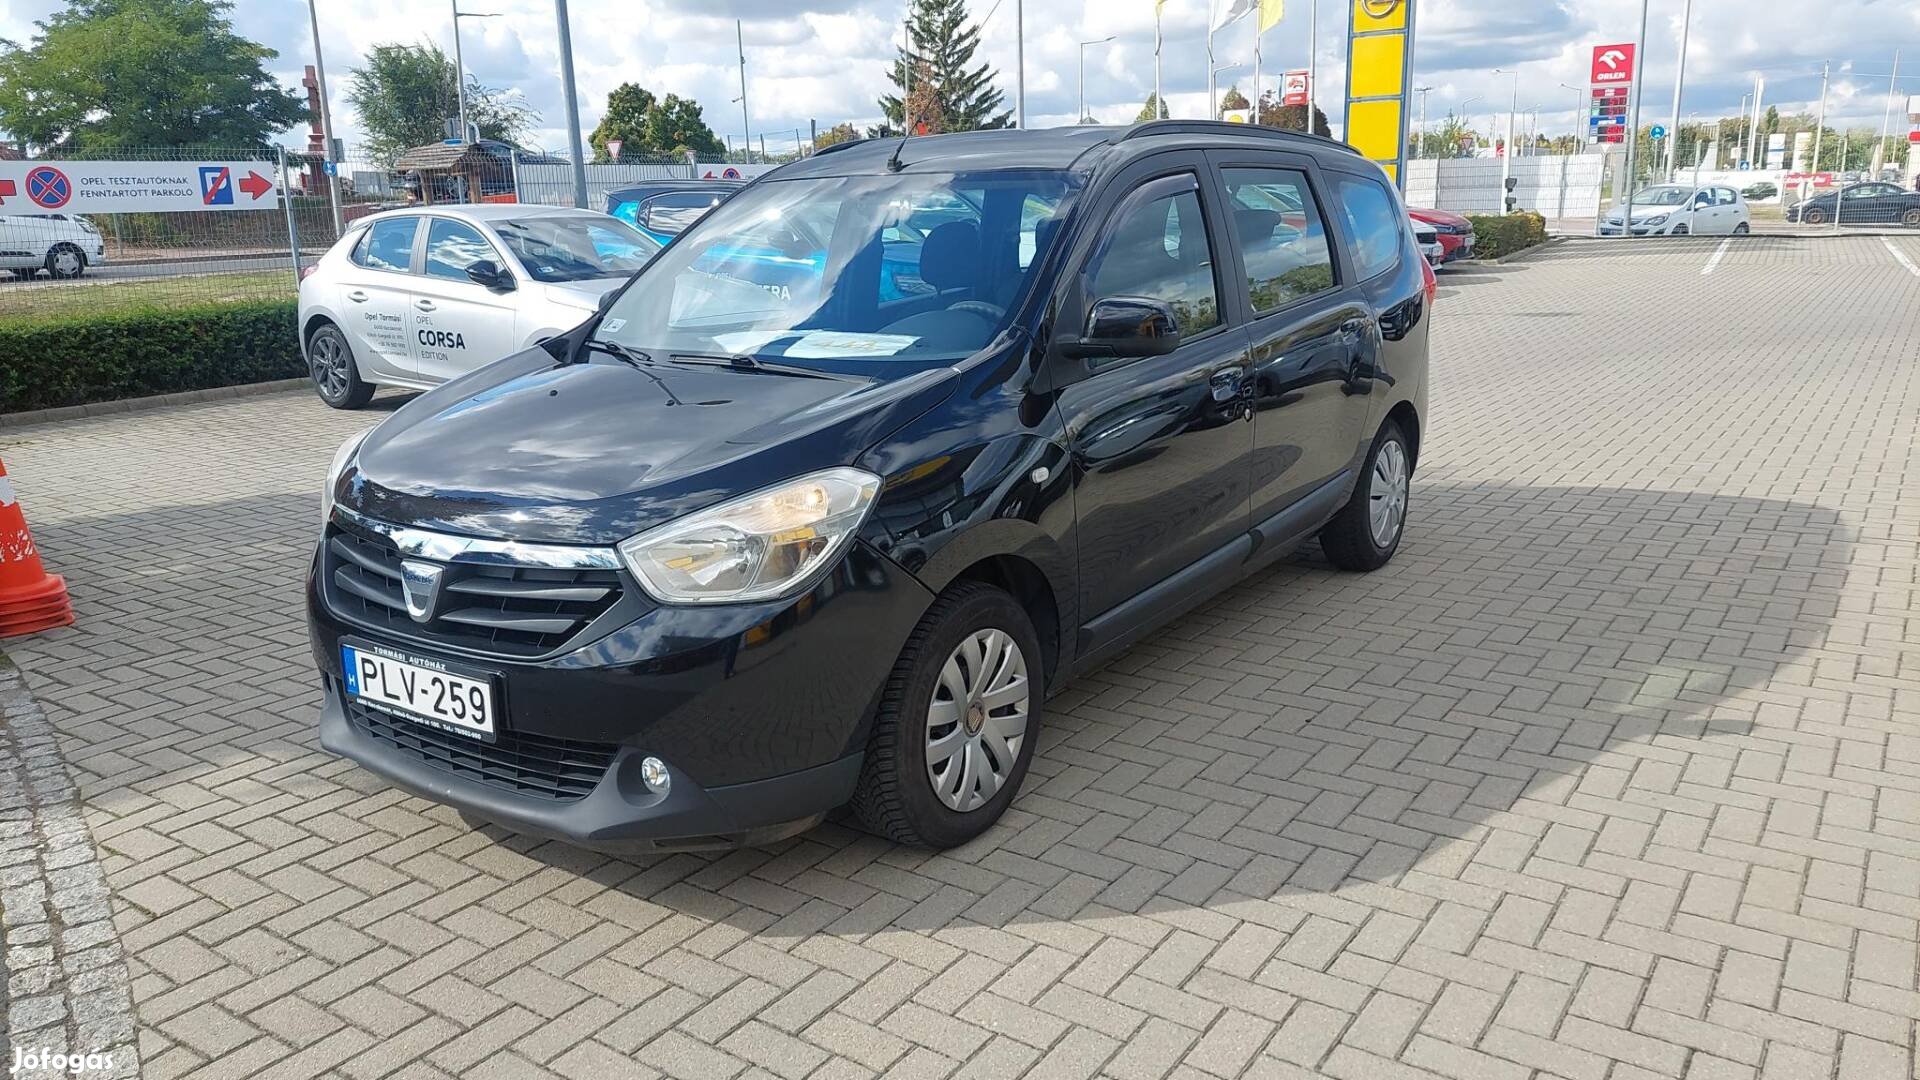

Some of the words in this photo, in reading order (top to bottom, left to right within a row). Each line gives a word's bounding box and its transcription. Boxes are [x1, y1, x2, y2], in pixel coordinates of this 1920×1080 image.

[1597, 72, 1626, 81] ORLEN
[80, 177, 106, 186] OPEL
[80, 189, 149, 198] FENNTARTOTT
[364, 311, 378, 322] Opel
[415, 315, 434, 326] OPEL
[418, 329, 466, 350] CORSA
[421, 350, 449, 361] EDITION
[348, 672, 356, 687] H
[360, 657, 486, 725] PLV-259
